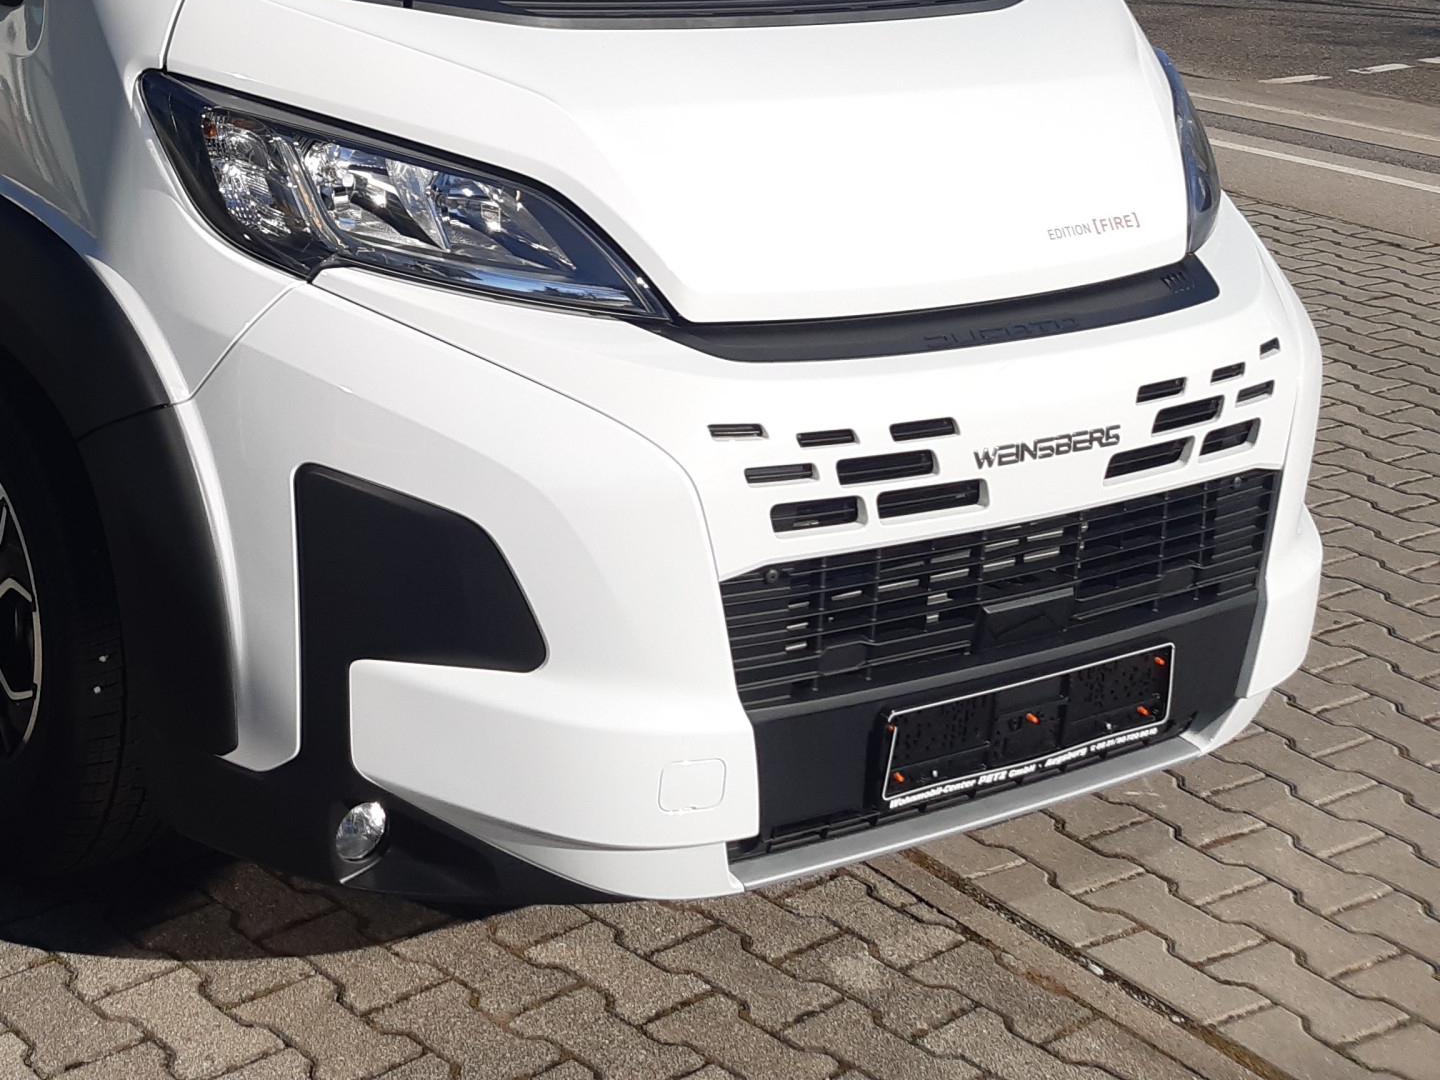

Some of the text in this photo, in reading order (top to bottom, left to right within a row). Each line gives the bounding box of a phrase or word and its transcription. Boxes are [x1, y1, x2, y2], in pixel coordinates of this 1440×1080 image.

[1047, 212, 1141, 240] EDITION [FIRE]
[973, 424, 1121, 470] WEINSBERG
[889, 779, 977, 809] Wohnmobil-Center
[977, 770, 1008, 785] PETZ
[1008, 763, 1037, 778] GmbH
[1044, 747, 1088, 768] Augsburg
